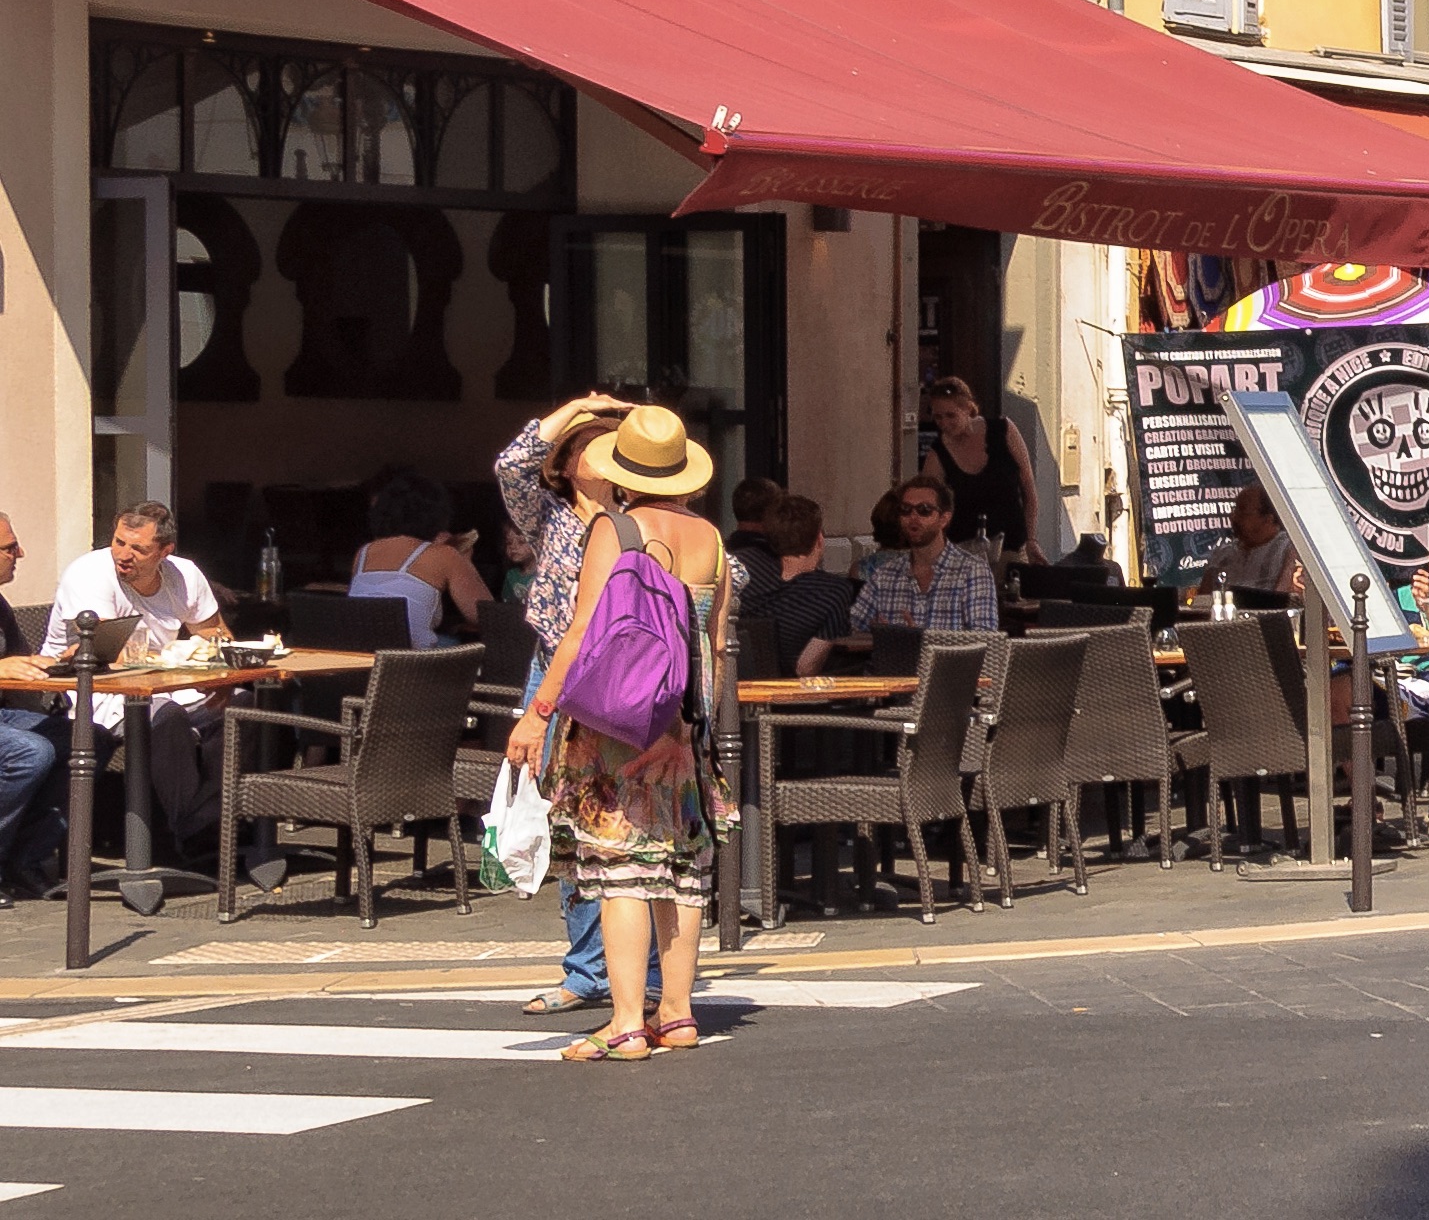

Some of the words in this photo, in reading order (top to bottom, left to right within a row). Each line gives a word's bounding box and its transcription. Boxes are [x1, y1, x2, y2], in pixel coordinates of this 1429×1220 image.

[1325, 380, 1340, 395] A
[1334, 350, 1373, 385] NICE
[1135, 362, 1284, 407] POPART
[1144, 428, 1195, 445] CREATION
[1145, 444, 1181, 460] CARTE
[1180, 443, 1195, 457] DE
[1195, 442, 1227, 456] VISITE
[1147, 460, 1178, 475] FLYER
[1186, 457, 1238, 471] BROCHURE
[1148, 473, 1200, 490] ENSEIGNE
[1151, 488, 1197, 505] STICKER
[1152, 502, 1218, 520] IMPRESSION
[1154, 518, 1208, 535] BOUTIQUE
[1207, 517, 1221, 529] EN
